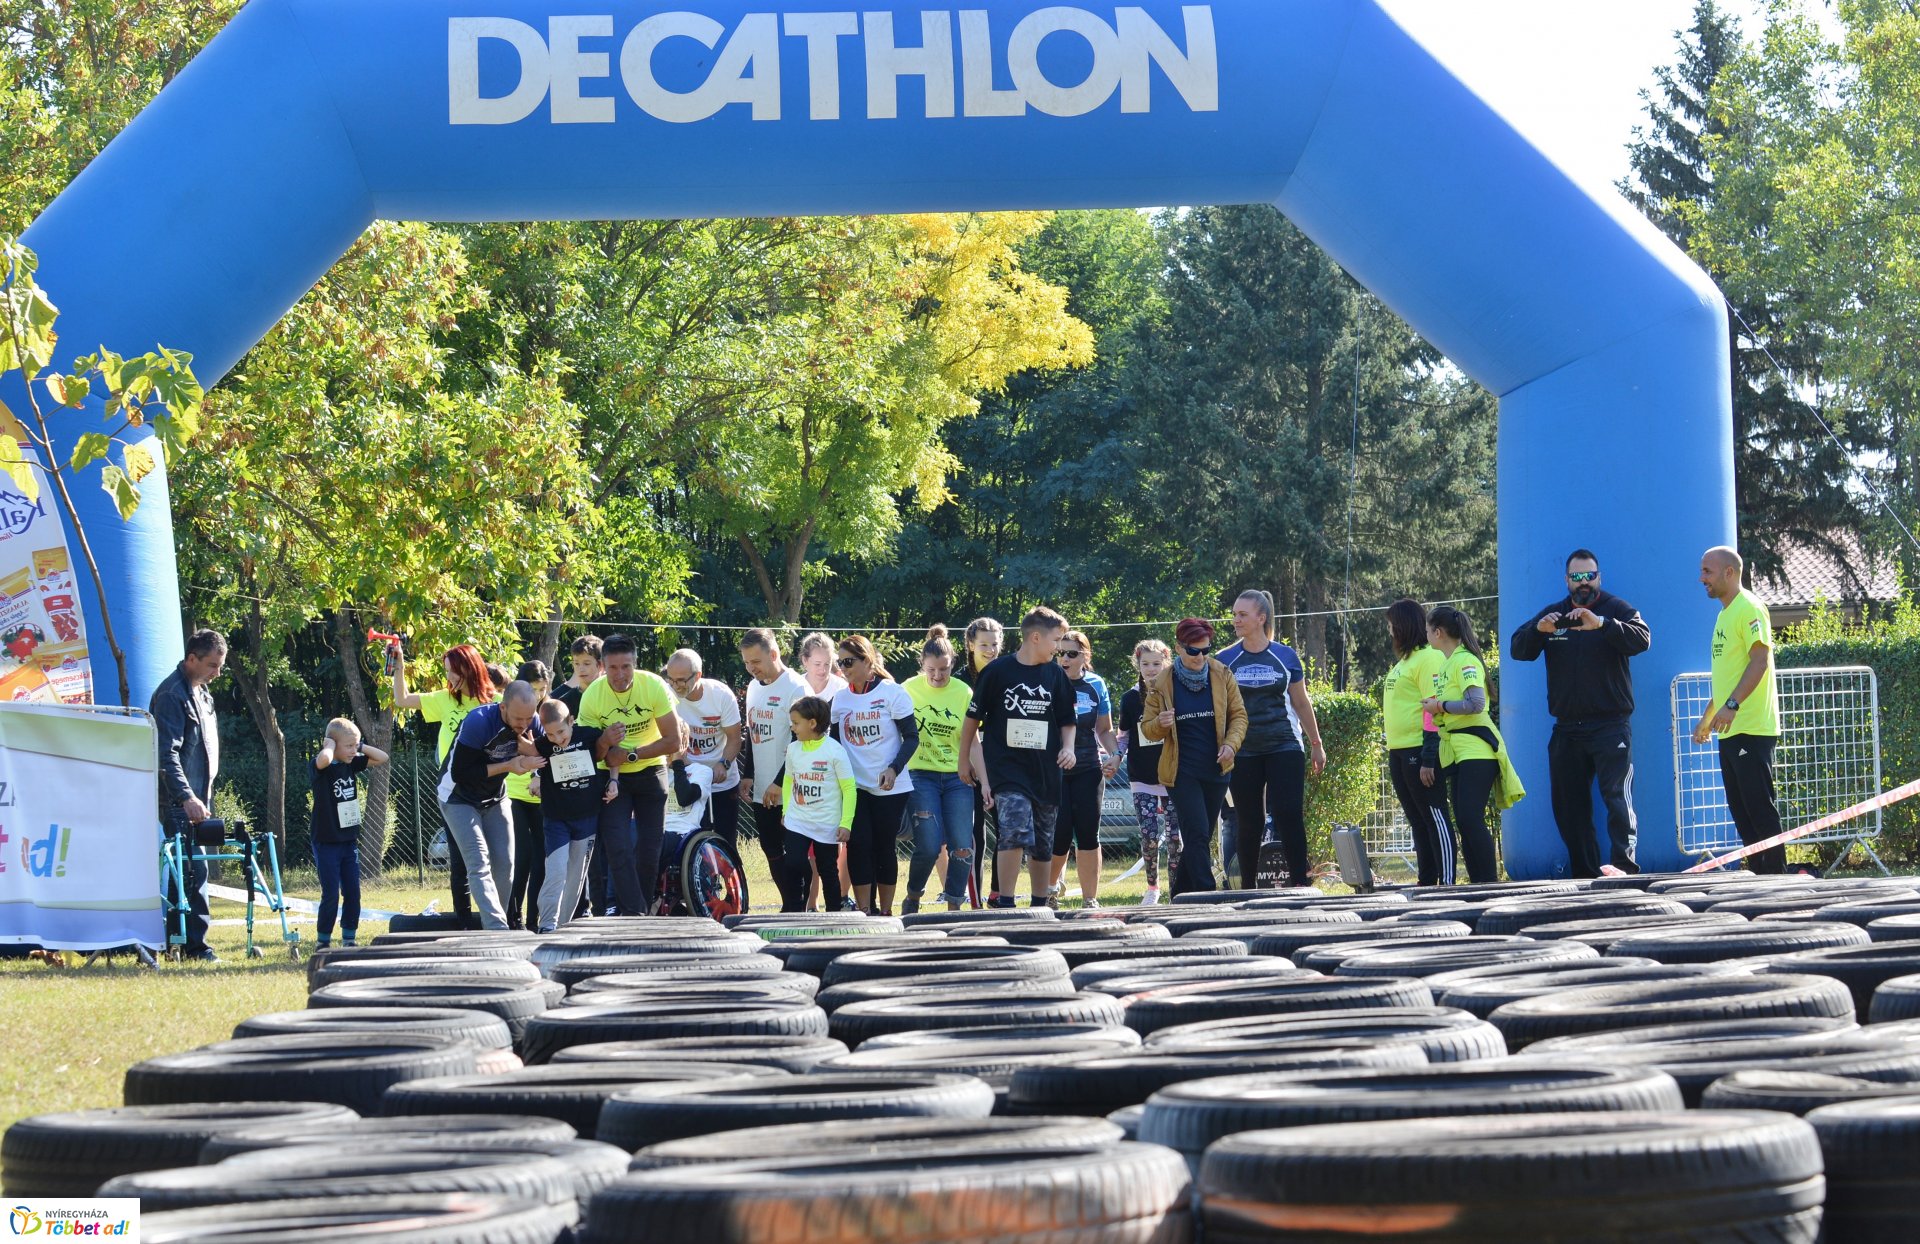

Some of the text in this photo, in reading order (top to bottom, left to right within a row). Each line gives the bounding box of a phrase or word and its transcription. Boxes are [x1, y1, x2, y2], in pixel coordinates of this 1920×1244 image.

[448, 5, 1220, 125] DECATHLON
[855, 708, 881, 721] HAJRÁ
[848, 724, 881, 738] MARCI
[793, 782, 822, 797] MARCI
